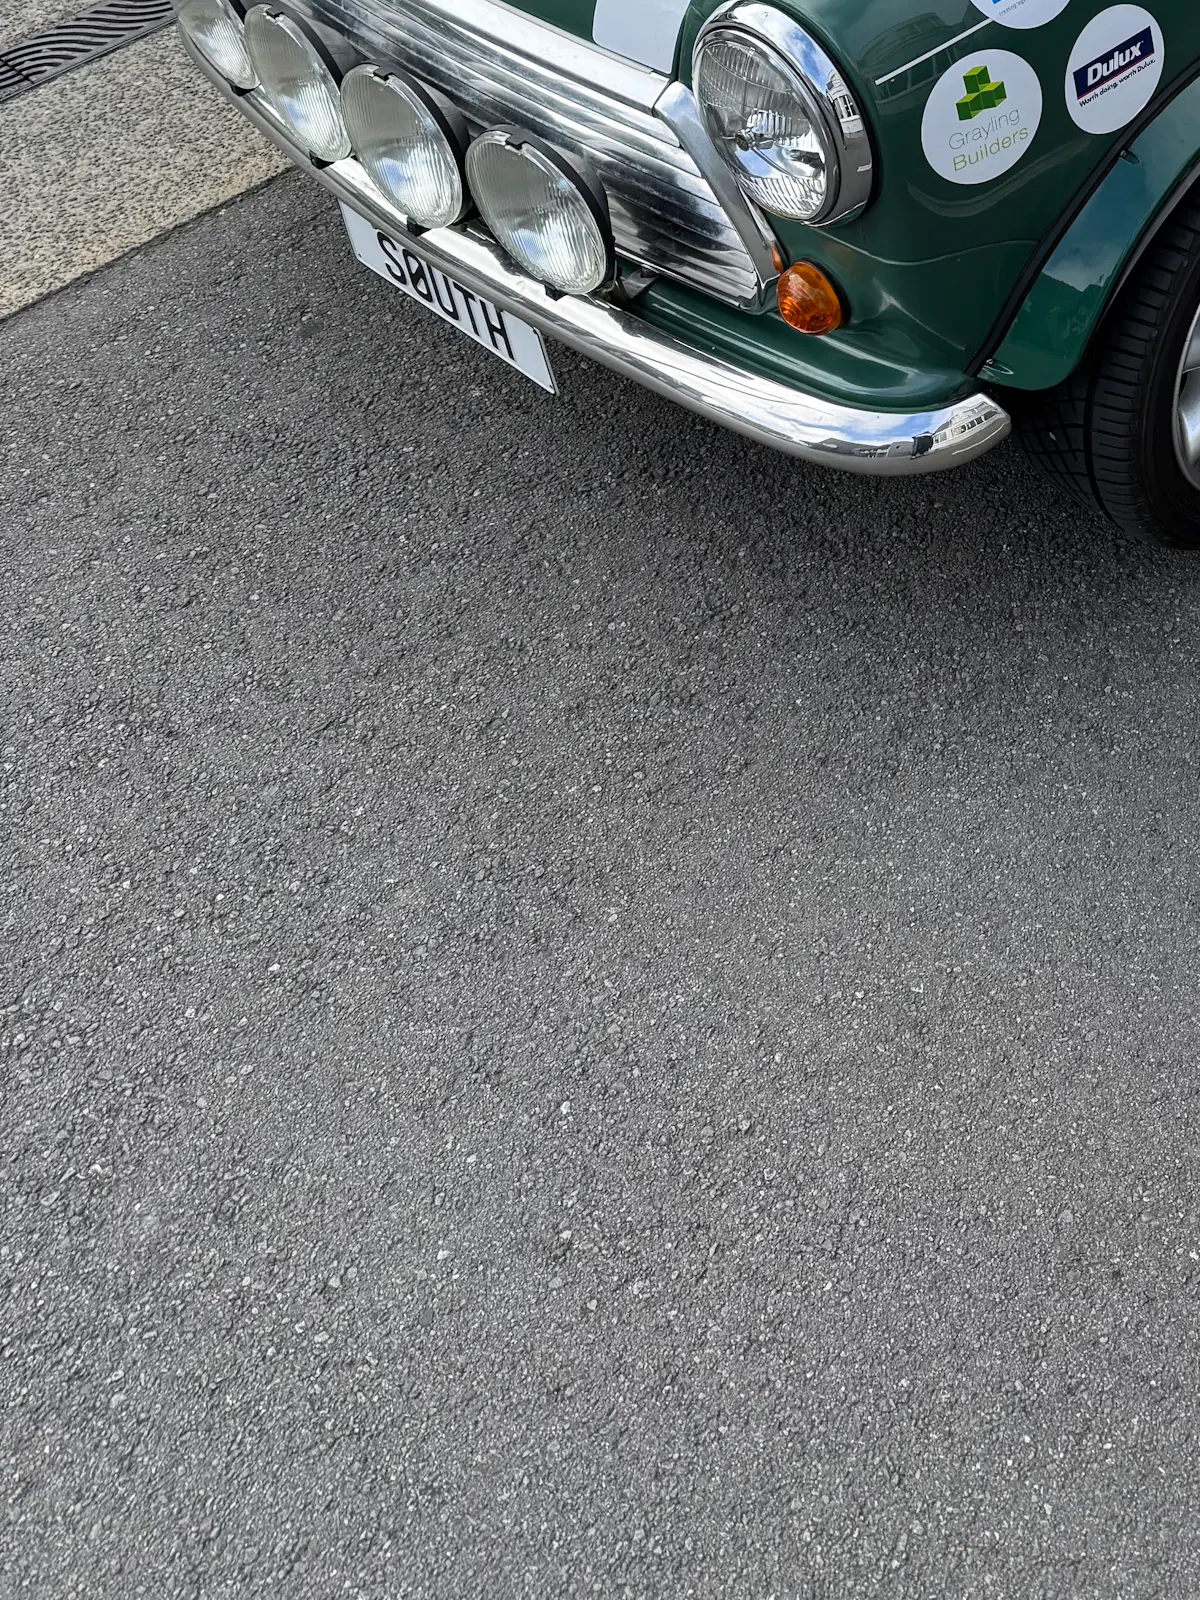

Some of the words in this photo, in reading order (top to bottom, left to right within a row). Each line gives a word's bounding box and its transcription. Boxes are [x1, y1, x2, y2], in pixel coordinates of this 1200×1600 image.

[1087, 43, 1141, 87] Dulux
[1079, 92, 1098, 107] Worth
[1119, 70, 1136, 84] worth
[949, 109, 1020, 150] Grayling
[953, 127, 1029, 171] Builders
